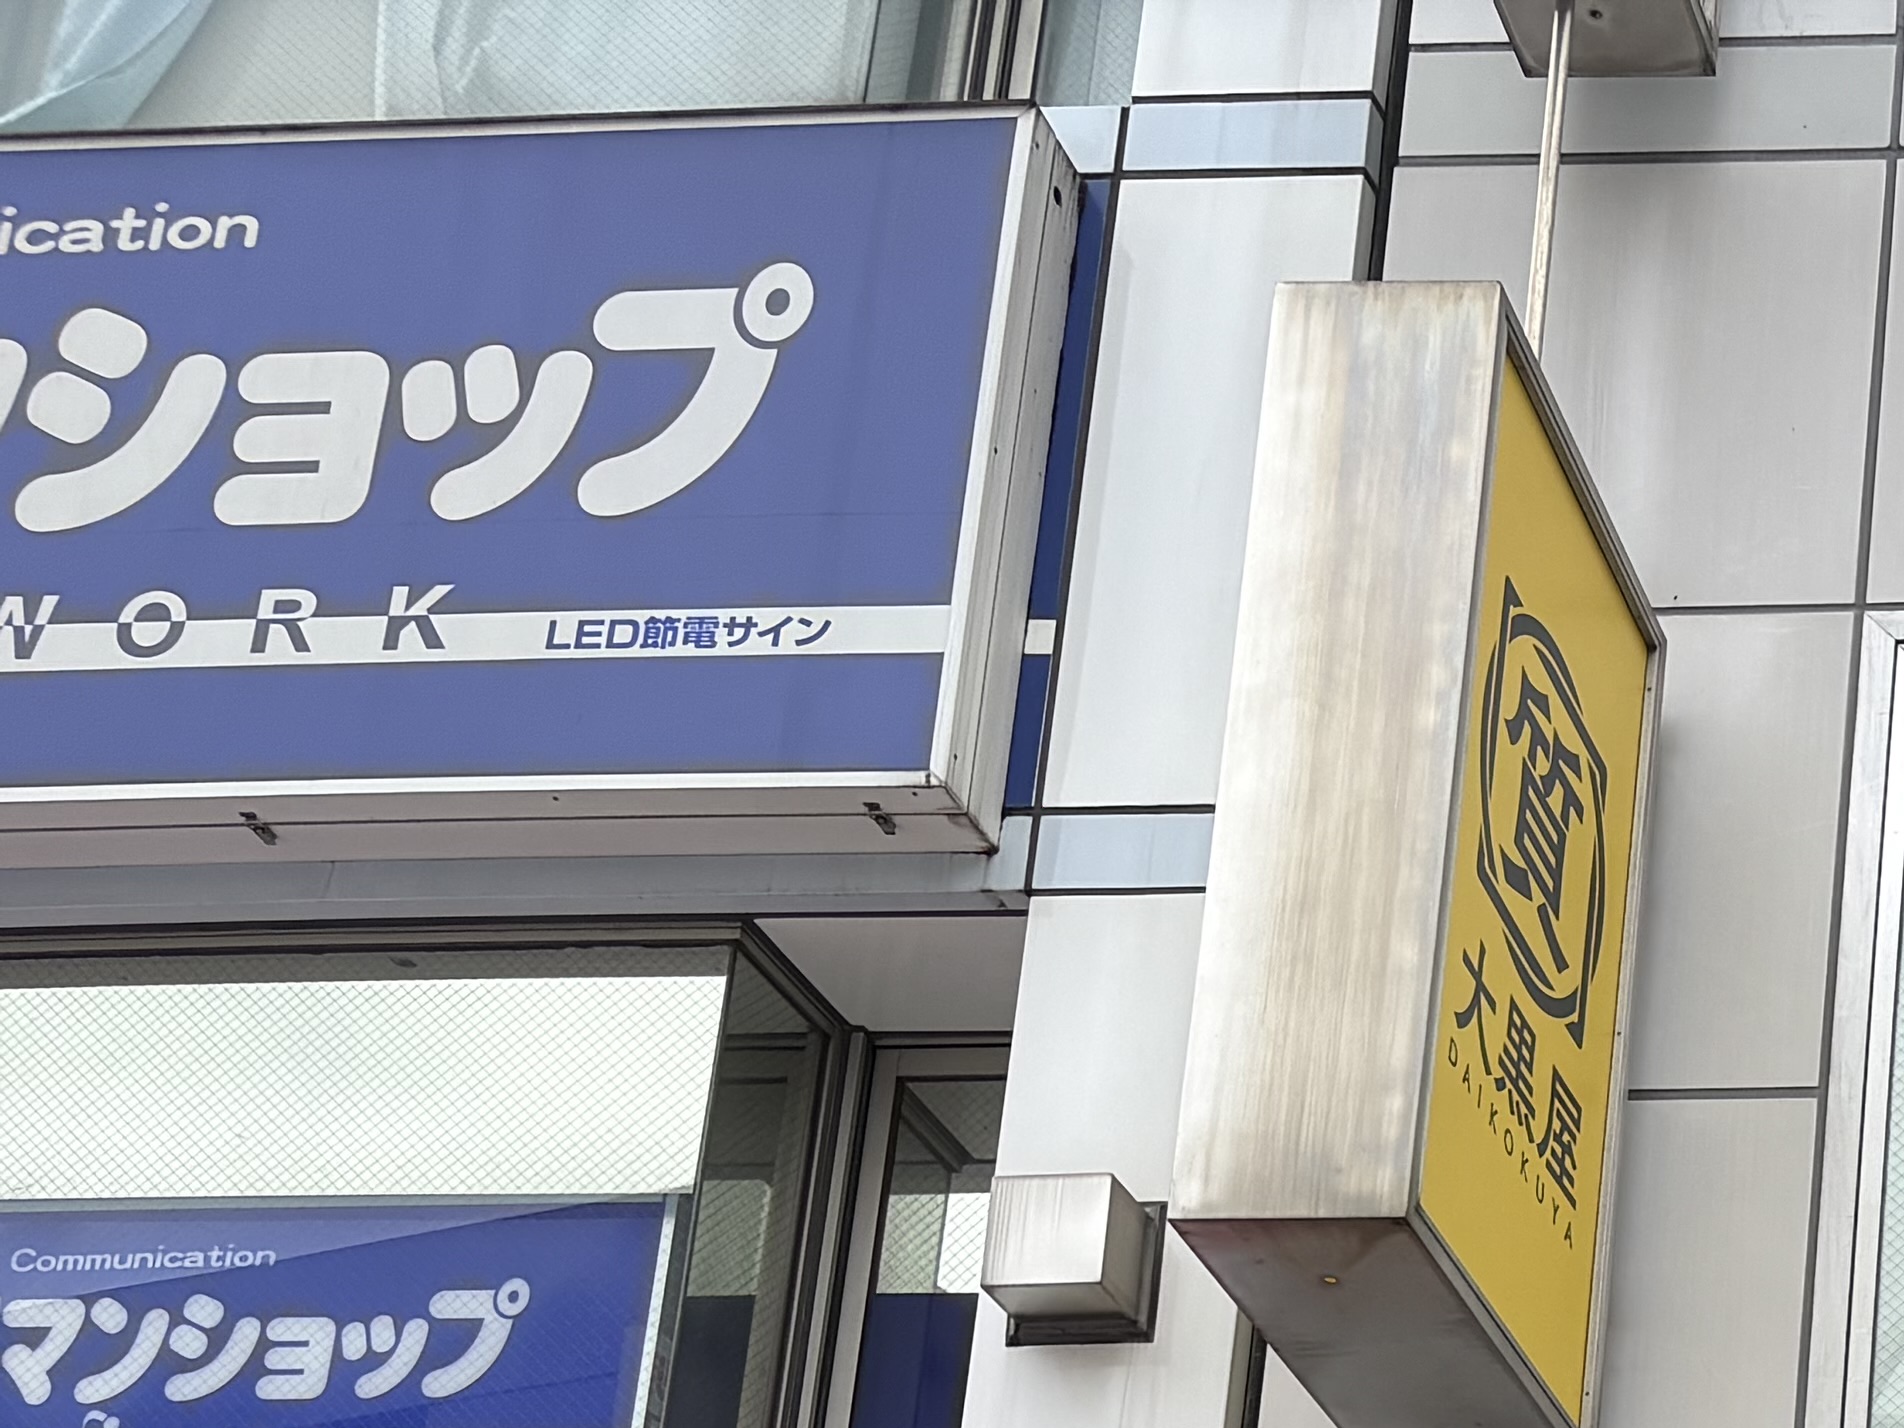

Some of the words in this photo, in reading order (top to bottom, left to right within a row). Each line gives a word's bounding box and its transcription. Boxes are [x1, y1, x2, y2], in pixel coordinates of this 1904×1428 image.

[544, 613, 833, 652] LED節電サイン
[1453, 939, 1584, 1212] 大黒屋
[1447, 1040, 1574, 1251] DAIKOKUYA
[10, 1243, 277, 1274] Communication
[2, 1278, 531, 1406] マンショップ
